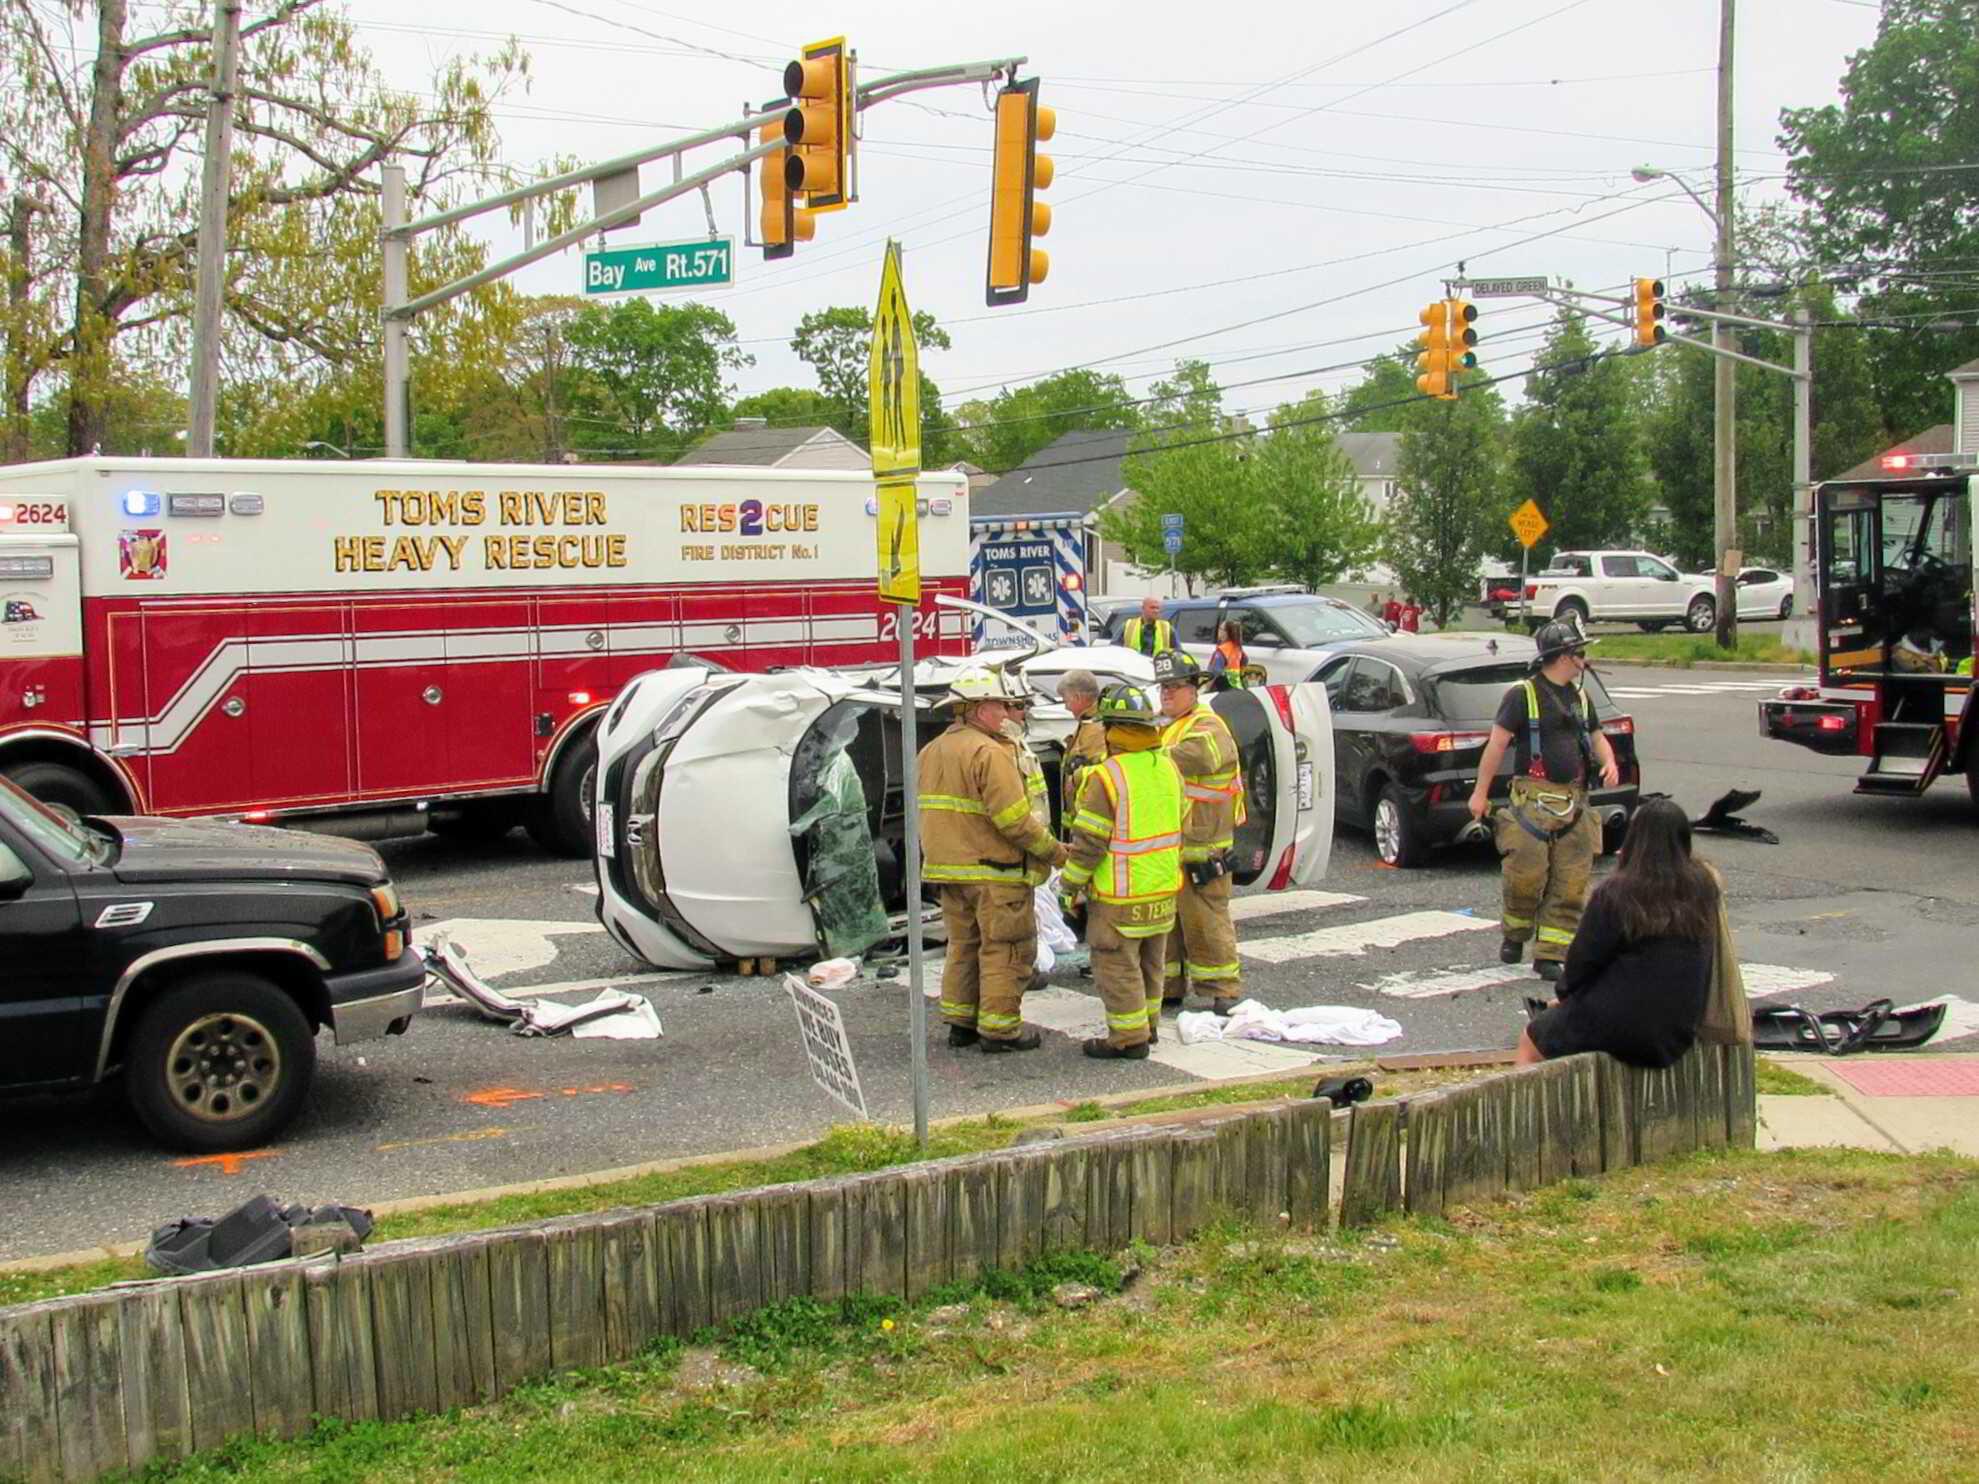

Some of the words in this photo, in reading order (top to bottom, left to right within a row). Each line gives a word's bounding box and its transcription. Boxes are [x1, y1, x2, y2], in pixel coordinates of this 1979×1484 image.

[588, 260, 625, 289] Bay
[634, 256, 657, 273] Ave
[666, 248, 728, 280] Rt.571
[1475, 280, 1513, 294] DELAYED
[1516, 279, 1546, 292] GREEN
[16, 503, 67, 524] 2624
[375, 490, 486, 526] TOMS
[499, 491, 608, 525] RIVER
[334, 535, 469, 572] HEAVY
[484, 534, 627, 570] RESCUE
[682, 545, 714, 561] FIRE
[720, 544, 786, 561] DISTRICT
[984, 547, 1016, 561] TOMS
[1019, 545, 1051, 559] RIVER
[880, 611, 937, 641] 224
[1155, 659, 1172, 672] 28
